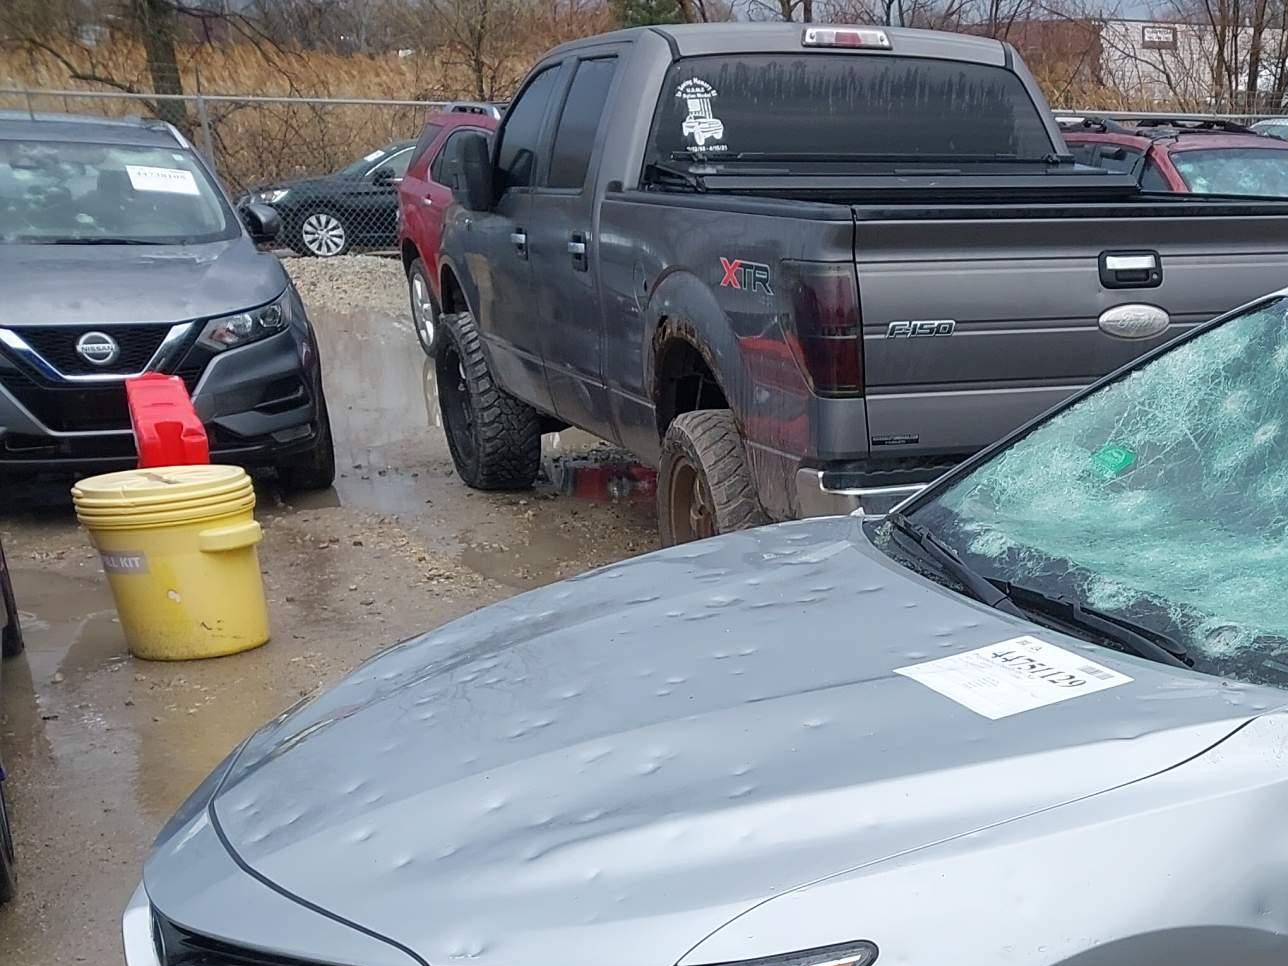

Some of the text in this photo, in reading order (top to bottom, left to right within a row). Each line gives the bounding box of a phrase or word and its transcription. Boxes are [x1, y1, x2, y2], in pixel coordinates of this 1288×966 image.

[719, 256, 775, 296] XTR
[81, 344, 114, 352] NISSAN
[119, 556, 141, 568] KIT
[991, 650, 1087, 688] 44751129
